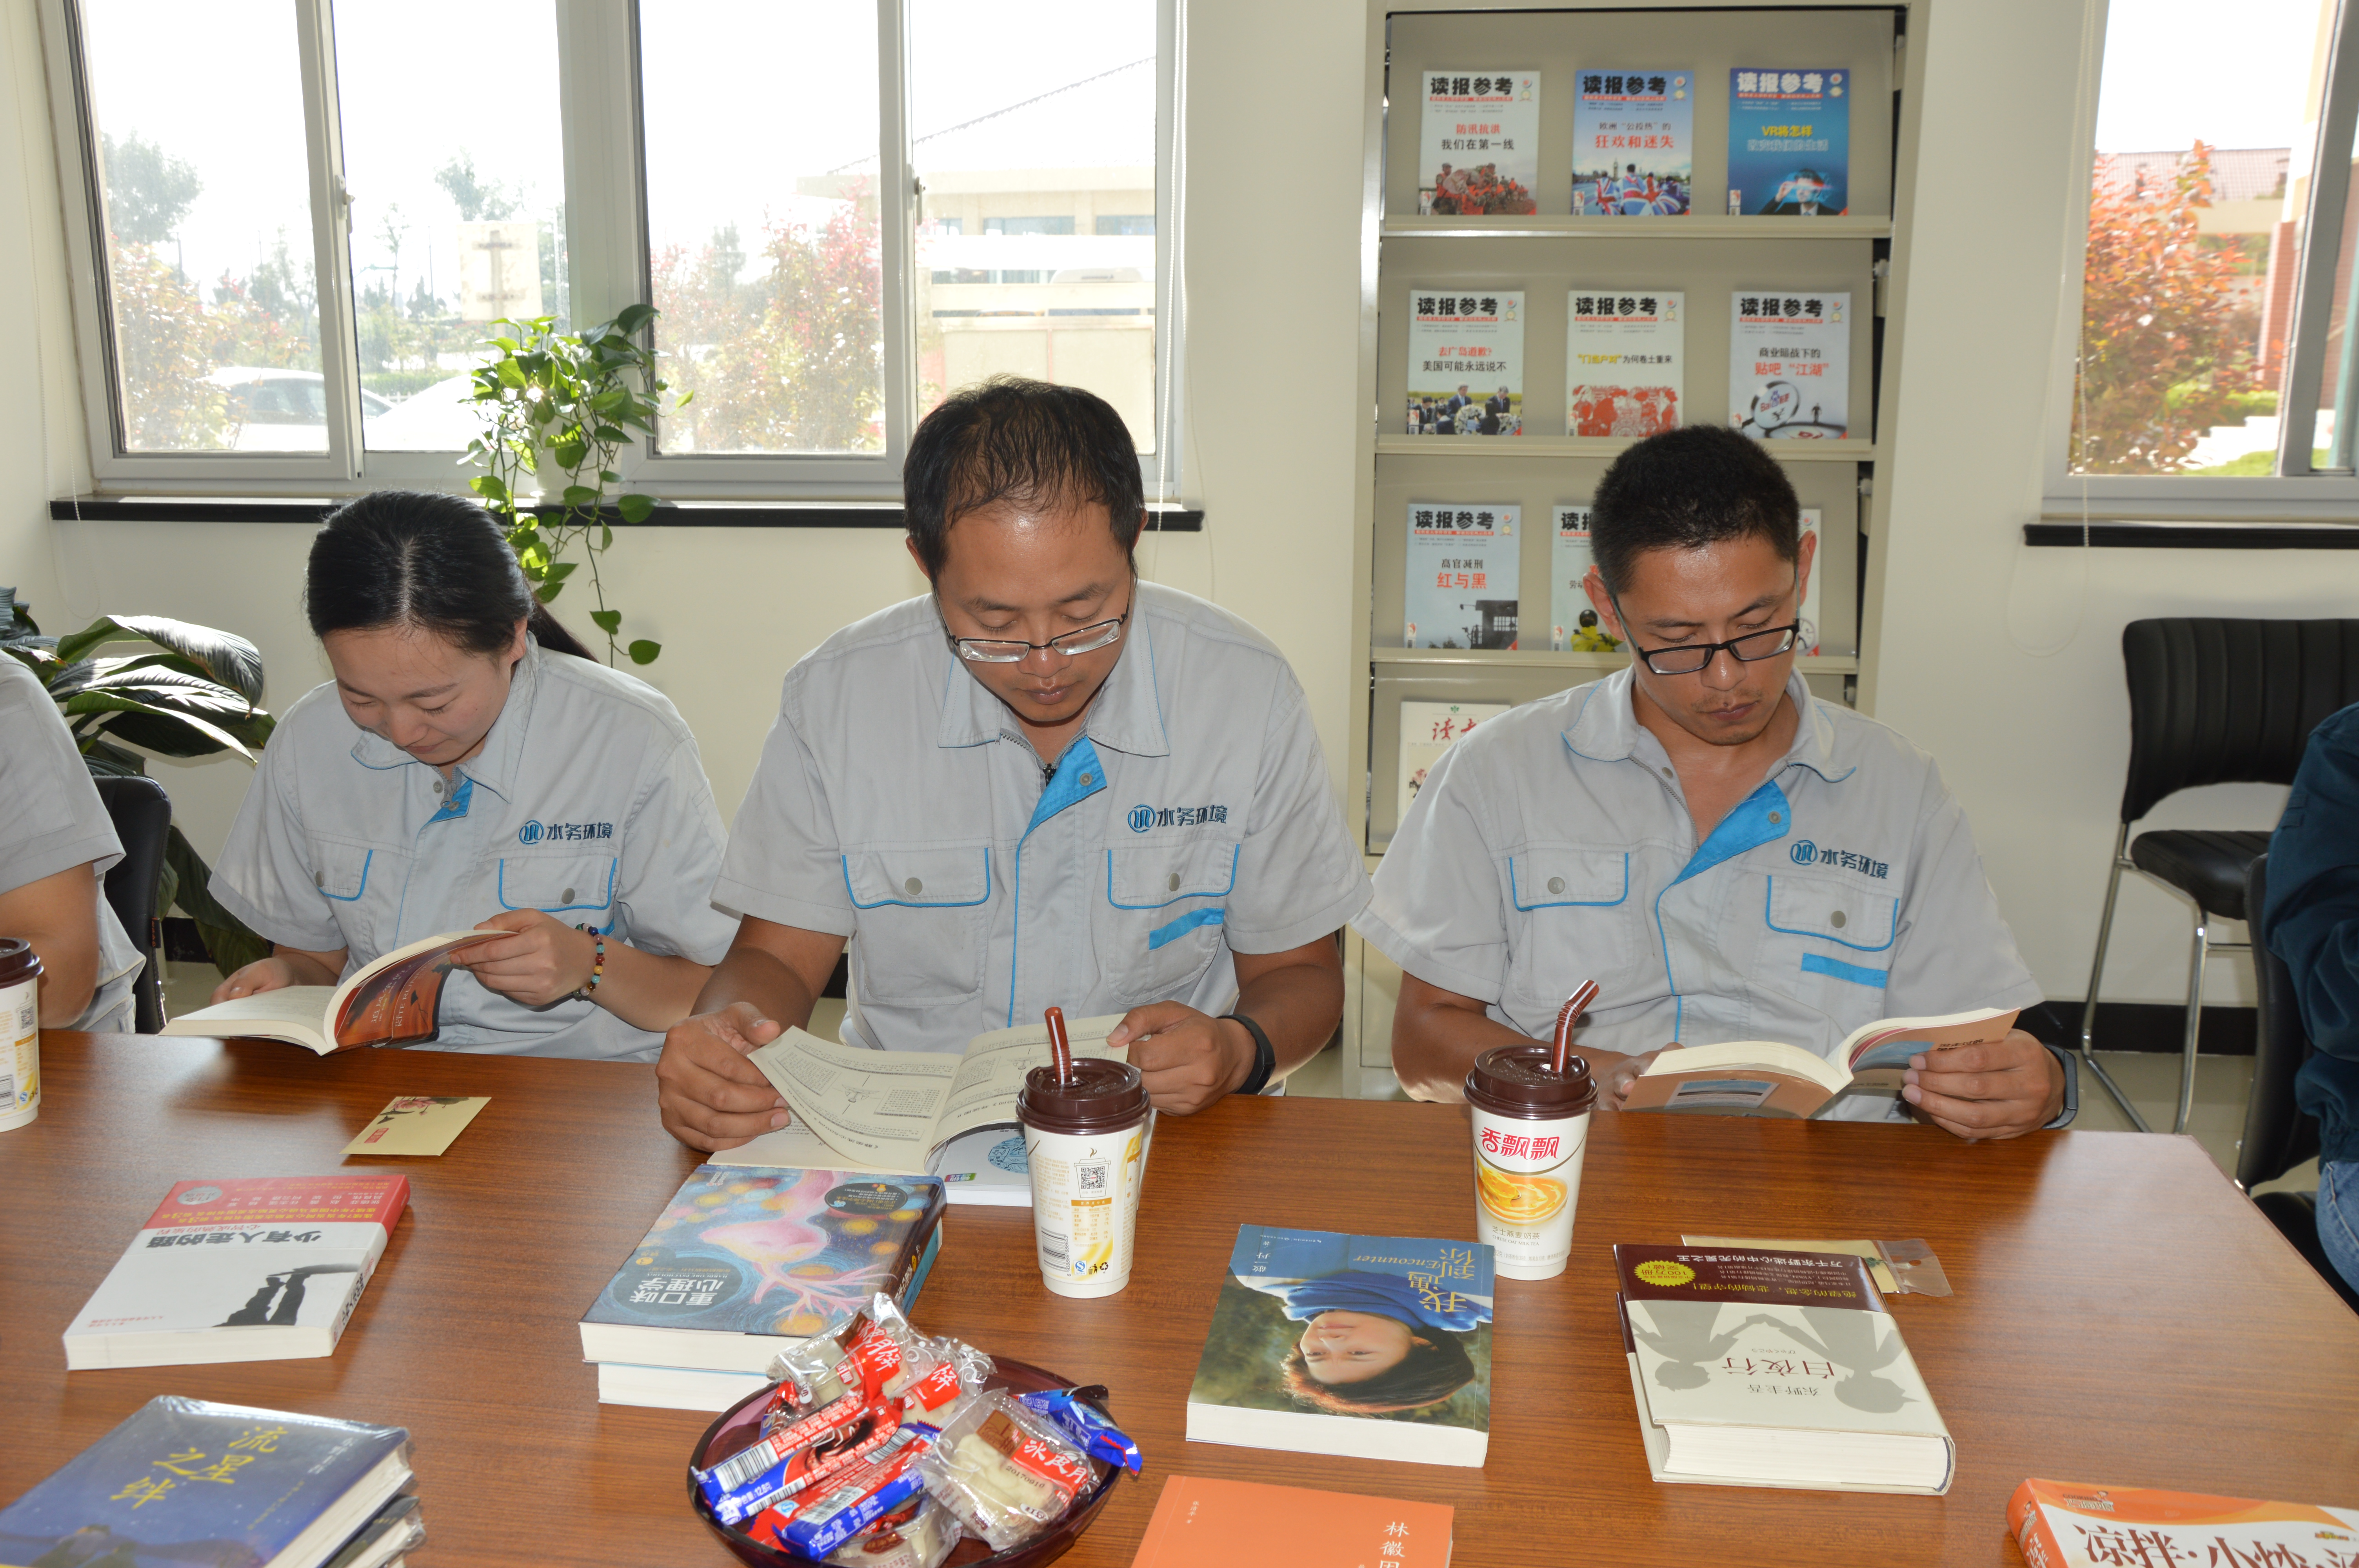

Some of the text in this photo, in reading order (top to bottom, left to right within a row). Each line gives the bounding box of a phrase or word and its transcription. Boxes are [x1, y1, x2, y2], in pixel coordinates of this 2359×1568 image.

[1431, 76, 1513, 95] 读报参考
[1583, 75, 1666, 95] 读报参考
[1738, 72, 1823, 93] 读报参考
[1456, 123, 1500, 134] 防汛抗洪
[1442, 139, 1514, 150] 我们在第一线
[1596, 135, 1674, 149] 狂欢和迷失
[1418, 297, 1498, 316] 读报参考
[1576, 297, 1657, 316] 读报参考
[1741, 298, 1823, 317] 读报参考
[1759, 348, 1821, 358] 商业暗战下的
[1423, 361, 1507, 372] 美国可能永远说不
[1416, 511, 1494, 530] 读报参考
[1442, 559, 1483, 569] 高官减刑
[1437, 572, 1487, 589] 红与黑
[1157, 805, 1227, 827] 水务环境
[547, 822, 613, 840] 水务环境
[1820, 849, 1889, 879] 水务环境
[1479, 1127, 1560, 1160] 香飘飘
[146, 1230, 322, 1248] 少有人走的路
[1492, 1225, 1540, 1240] 芝士燕麦奶茶
[1492, 1234, 1507, 1243] CHEESE
[1353, 1255, 1441, 1269] Encounter
[1676, 1255, 1843, 1268] 万千东野迷心中的无冕之王
[638, 1278, 724, 1292] 心理学
[629, 1290, 718, 1306] 重口味
[1721, 1357, 1836, 1379] 白夜行
[1747, 1384, 1821, 1397] 东野圭吾
[1005, 1466, 1045, 1488] 20170910
